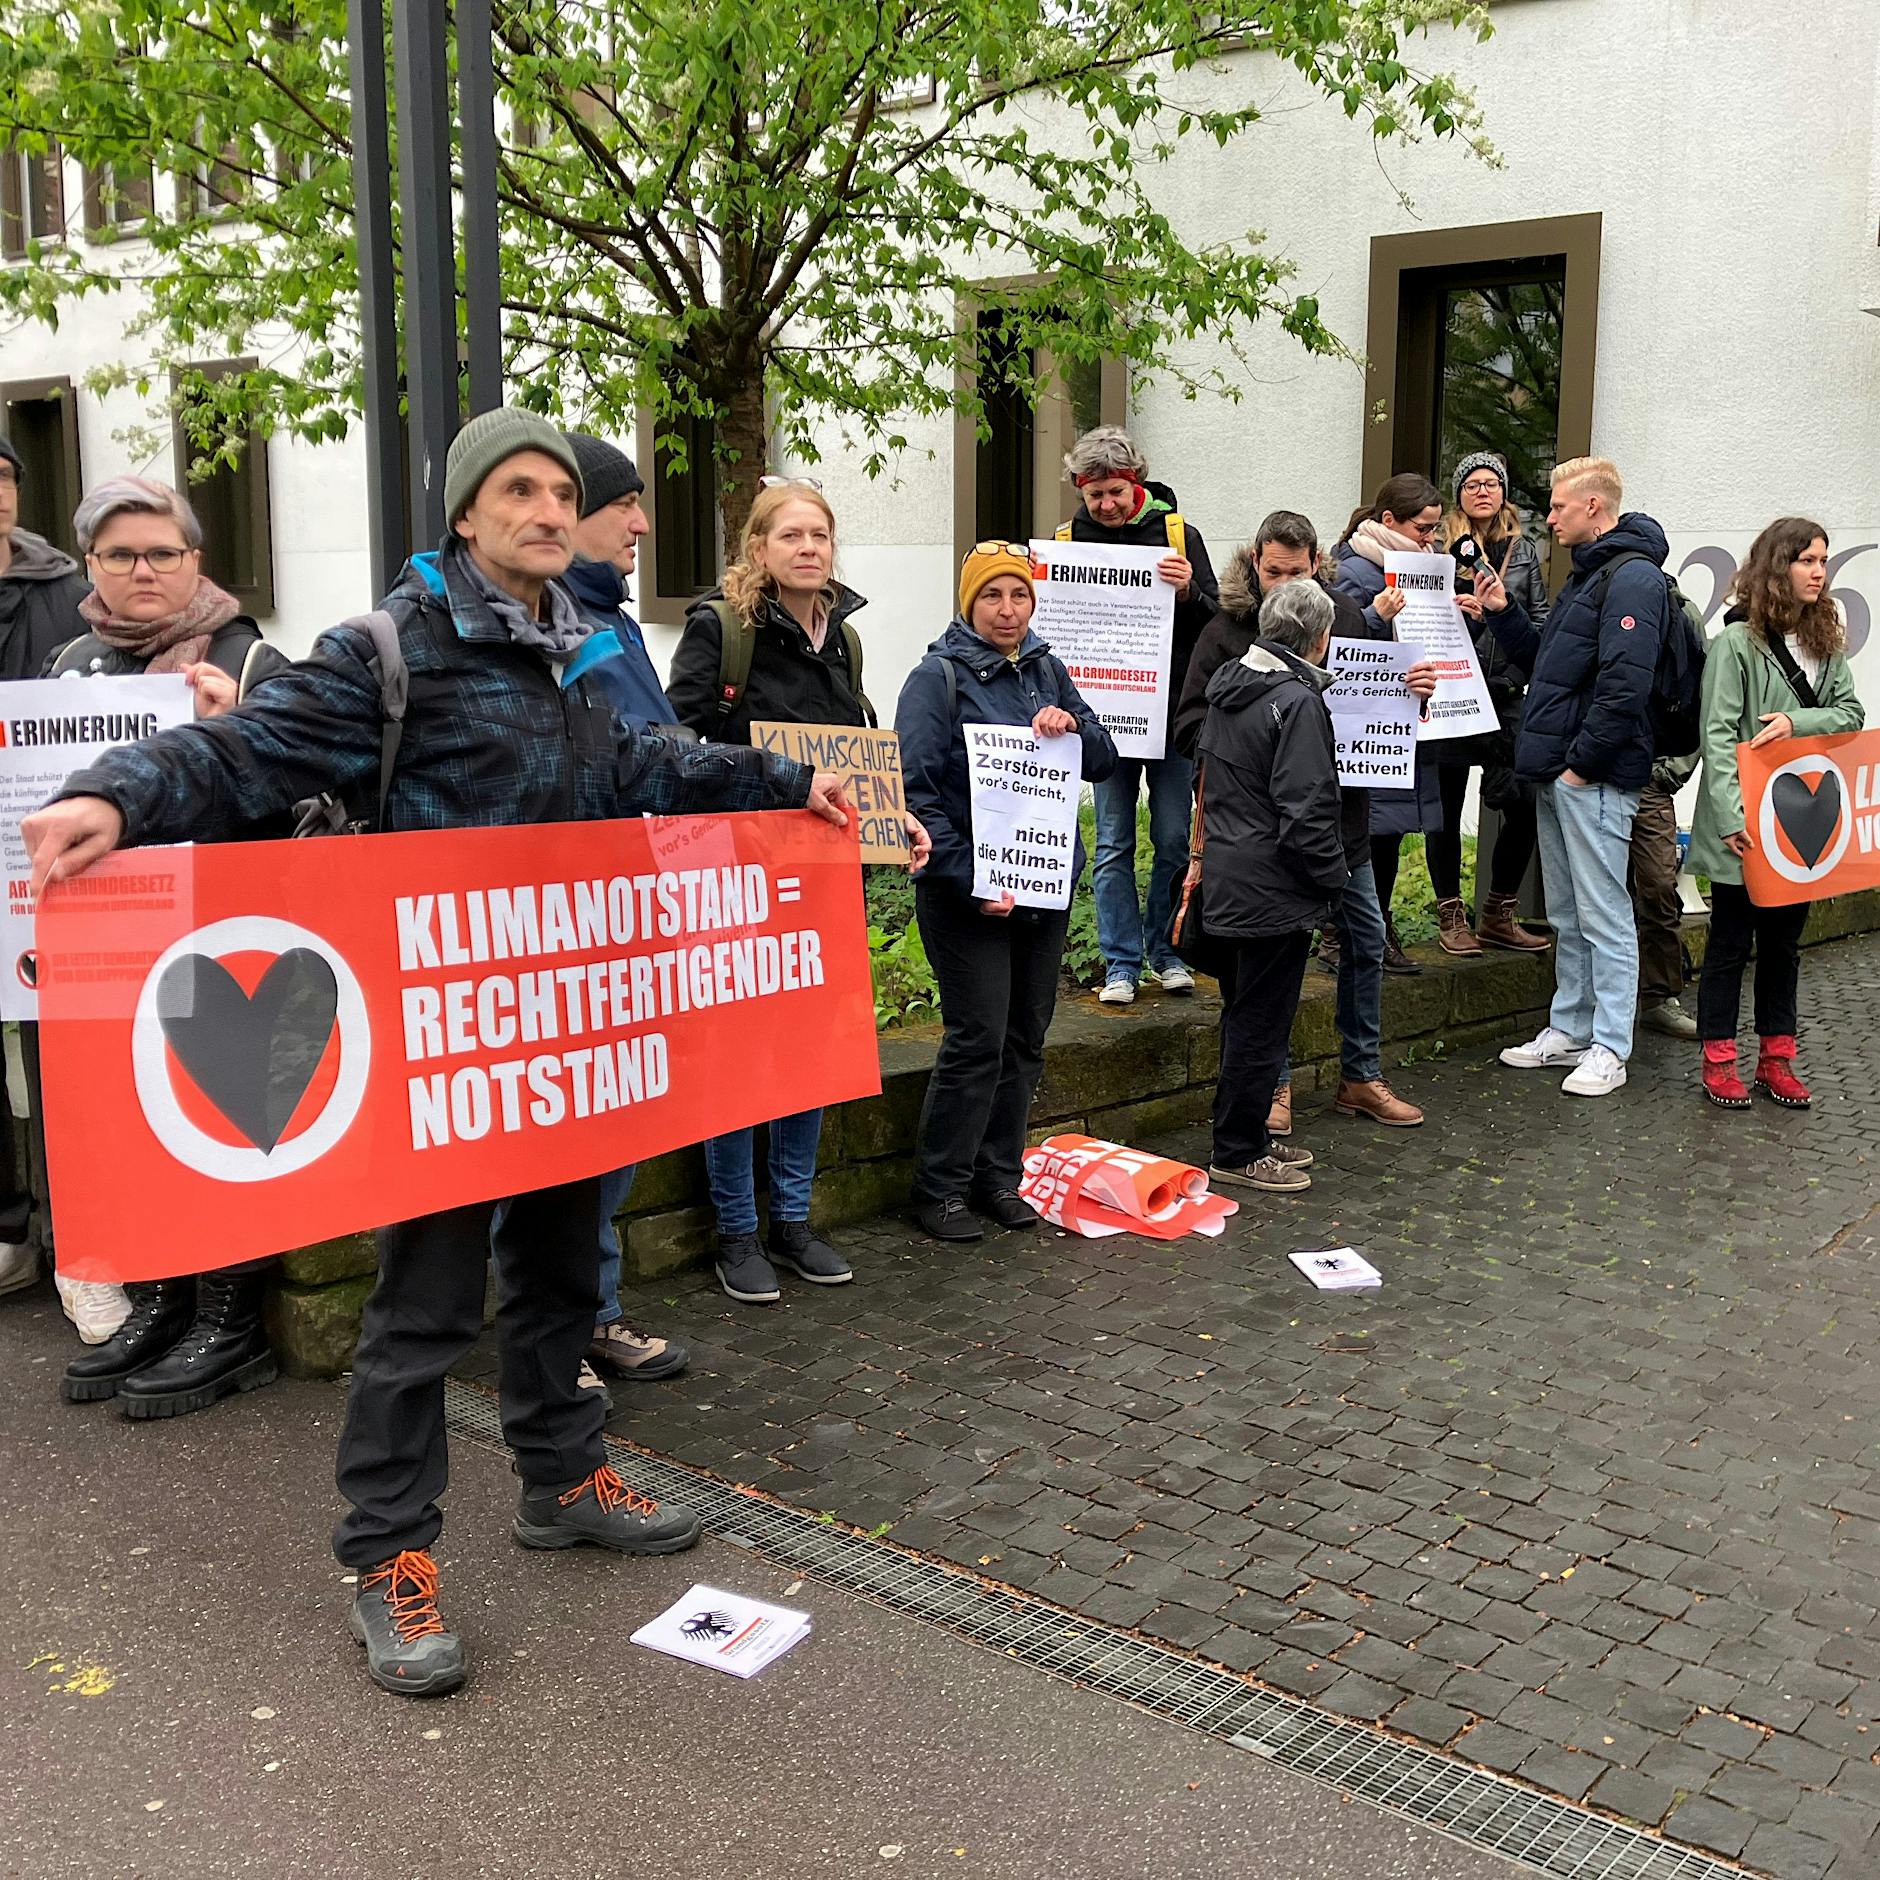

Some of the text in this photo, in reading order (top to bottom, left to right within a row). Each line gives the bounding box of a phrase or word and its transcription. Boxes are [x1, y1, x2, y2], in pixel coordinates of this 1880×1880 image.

[1051, 564, 1152, 588] ERINNERUNG
[1397, 573, 1445, 591] ERINNERUNG
[1335, 646, 1394, 663] Klima-
[1067, 665, 1158, 683] 0A GRUNDGESETZ
[1333, 667, 1407, 682] Zerstöre
[1113, 683, 1157, 693] DEUTSCHLAND
[1329, 687, 1411, 699] vor's Gericht,
[1102, 714, 1149, 726] GENERATION
[1365, 721, 1412, 736] nicht
[10, 713, 157, 747] ERINNERUNG
[973, 731, 1040, 753] Klima-
[1351, 740, 1409, 756] Klima-
[976, 753, 1070, 782] Zerstörer
[1336, 759, 1408, 776] Aktiven!
[16, 774, 35, 783] Staat
[977, 776, 1066, 803] vor's Gericht,
[1015, 827, 1067, 848] nicht
[978, 843, 1065, 871] die Klima-
[989, 869, 1063, 895] Aktiven!
[10, 904, 26, 915] FÜR
[395, 863, 800, 971] KLIMANOTSTAND =
[400, 929, 824, 1061] RECHTFERTIGENDER
[407, 1032, 669, 1151] NOTSTAND
